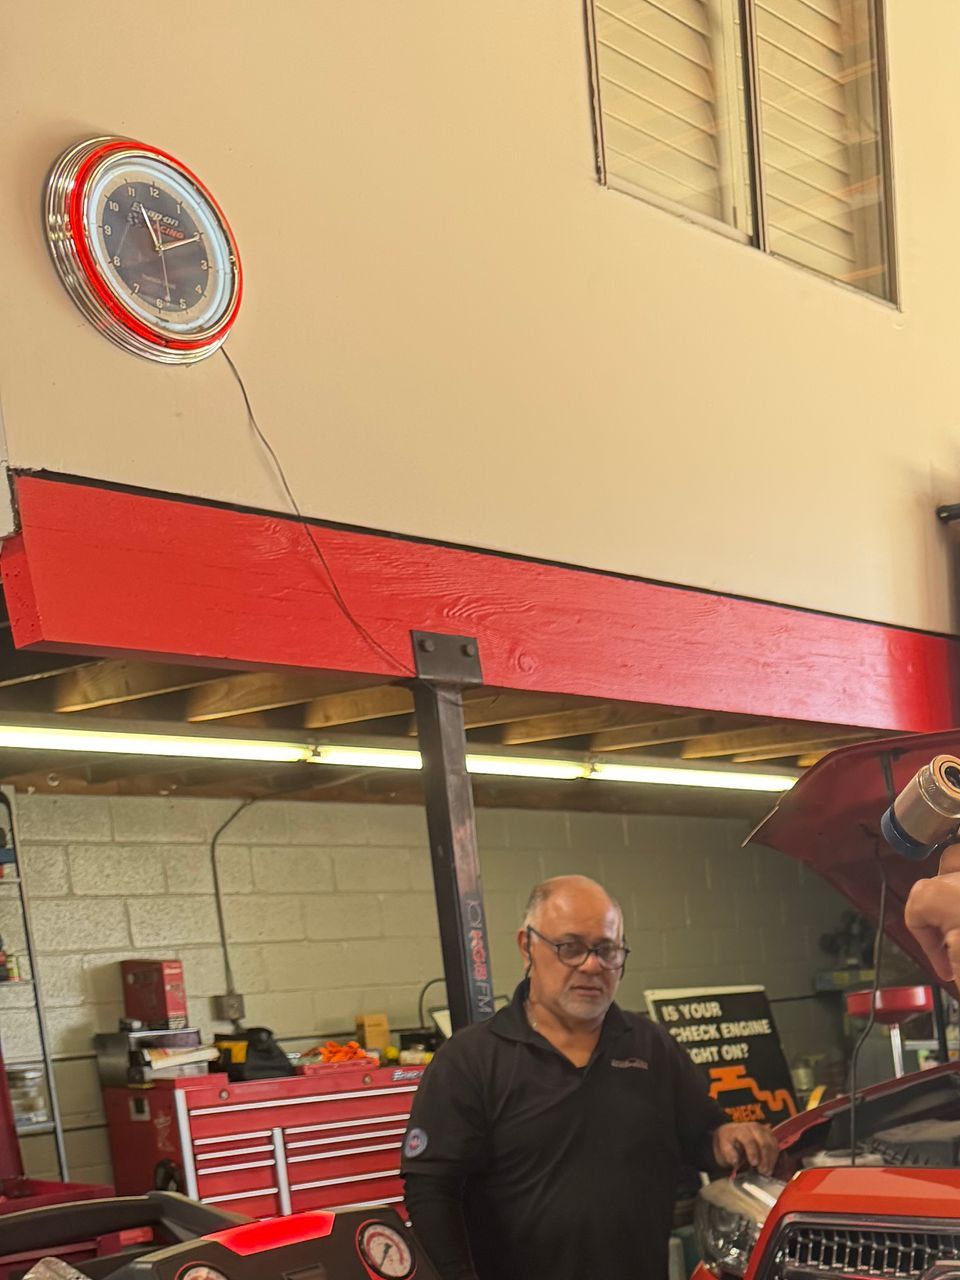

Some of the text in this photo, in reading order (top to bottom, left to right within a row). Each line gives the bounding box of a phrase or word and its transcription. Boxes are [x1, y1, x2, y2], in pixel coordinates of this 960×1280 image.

[149, 187, 160, 198] 12
[109, 201, 119, 212] 10
[131, 202, 179, 227] Sap-on
[104, 225, 112, 235] 9
[113, 256, 121, 266] 8
[201, 260, 208, 270] 3
[195, 284, 202, 294] 4
[662, 1002, 722, 1022] IS YOUR
[720, 1019, 772, 1038] ENGINE
[686, 1043, 750, 1064] GHT ON?
